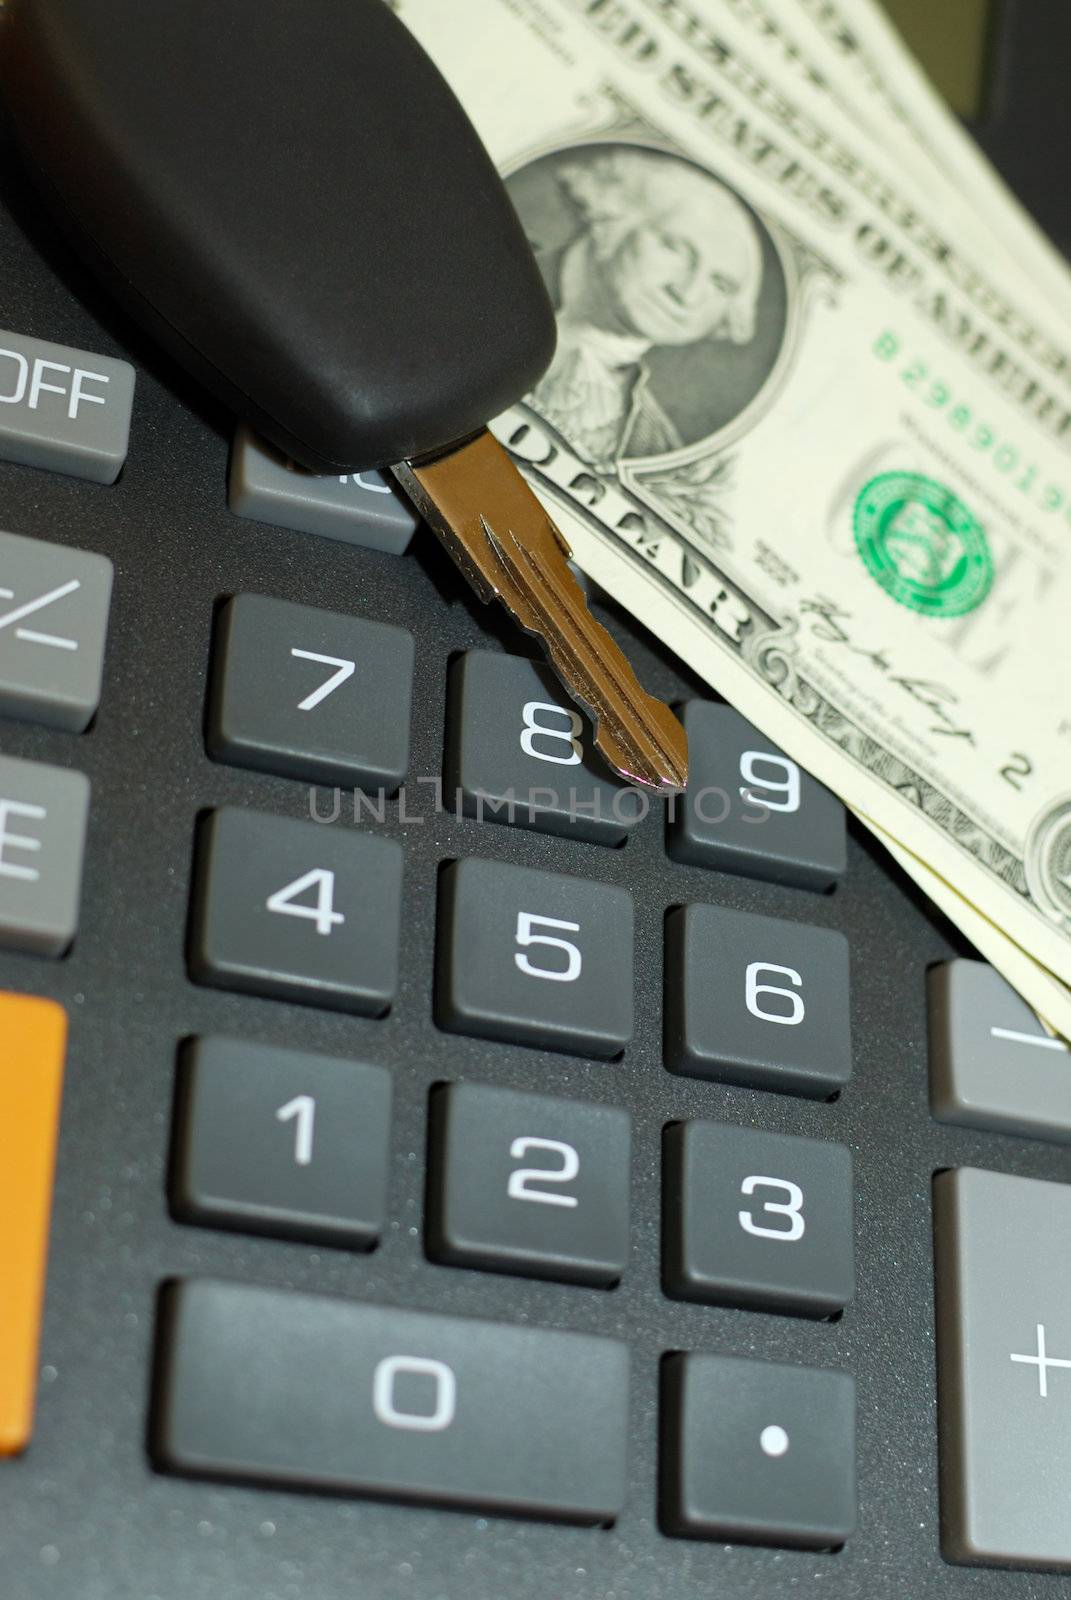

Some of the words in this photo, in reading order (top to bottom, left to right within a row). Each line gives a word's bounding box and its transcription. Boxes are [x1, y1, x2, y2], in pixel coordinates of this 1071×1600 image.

[657, 60, 845, 222] STATES
[855, 221, 924, 292] OF
[291, 648, 356, 711] 7
[519, 701, 584, 766] 8
[739, 750, 801, 813] 9
[998, 750, 1033, 793] 2
[266, 868, 345, 935] 4
[514, 911, 582, 982] 5
[745, 961, 805, 1026] 6
[278, 1095, 315, 1165] 1
[508, 1136, 579, 1207] 2
[738, 1175, 805, 1241] 3
[373, 1355, 456, 1430] 0
